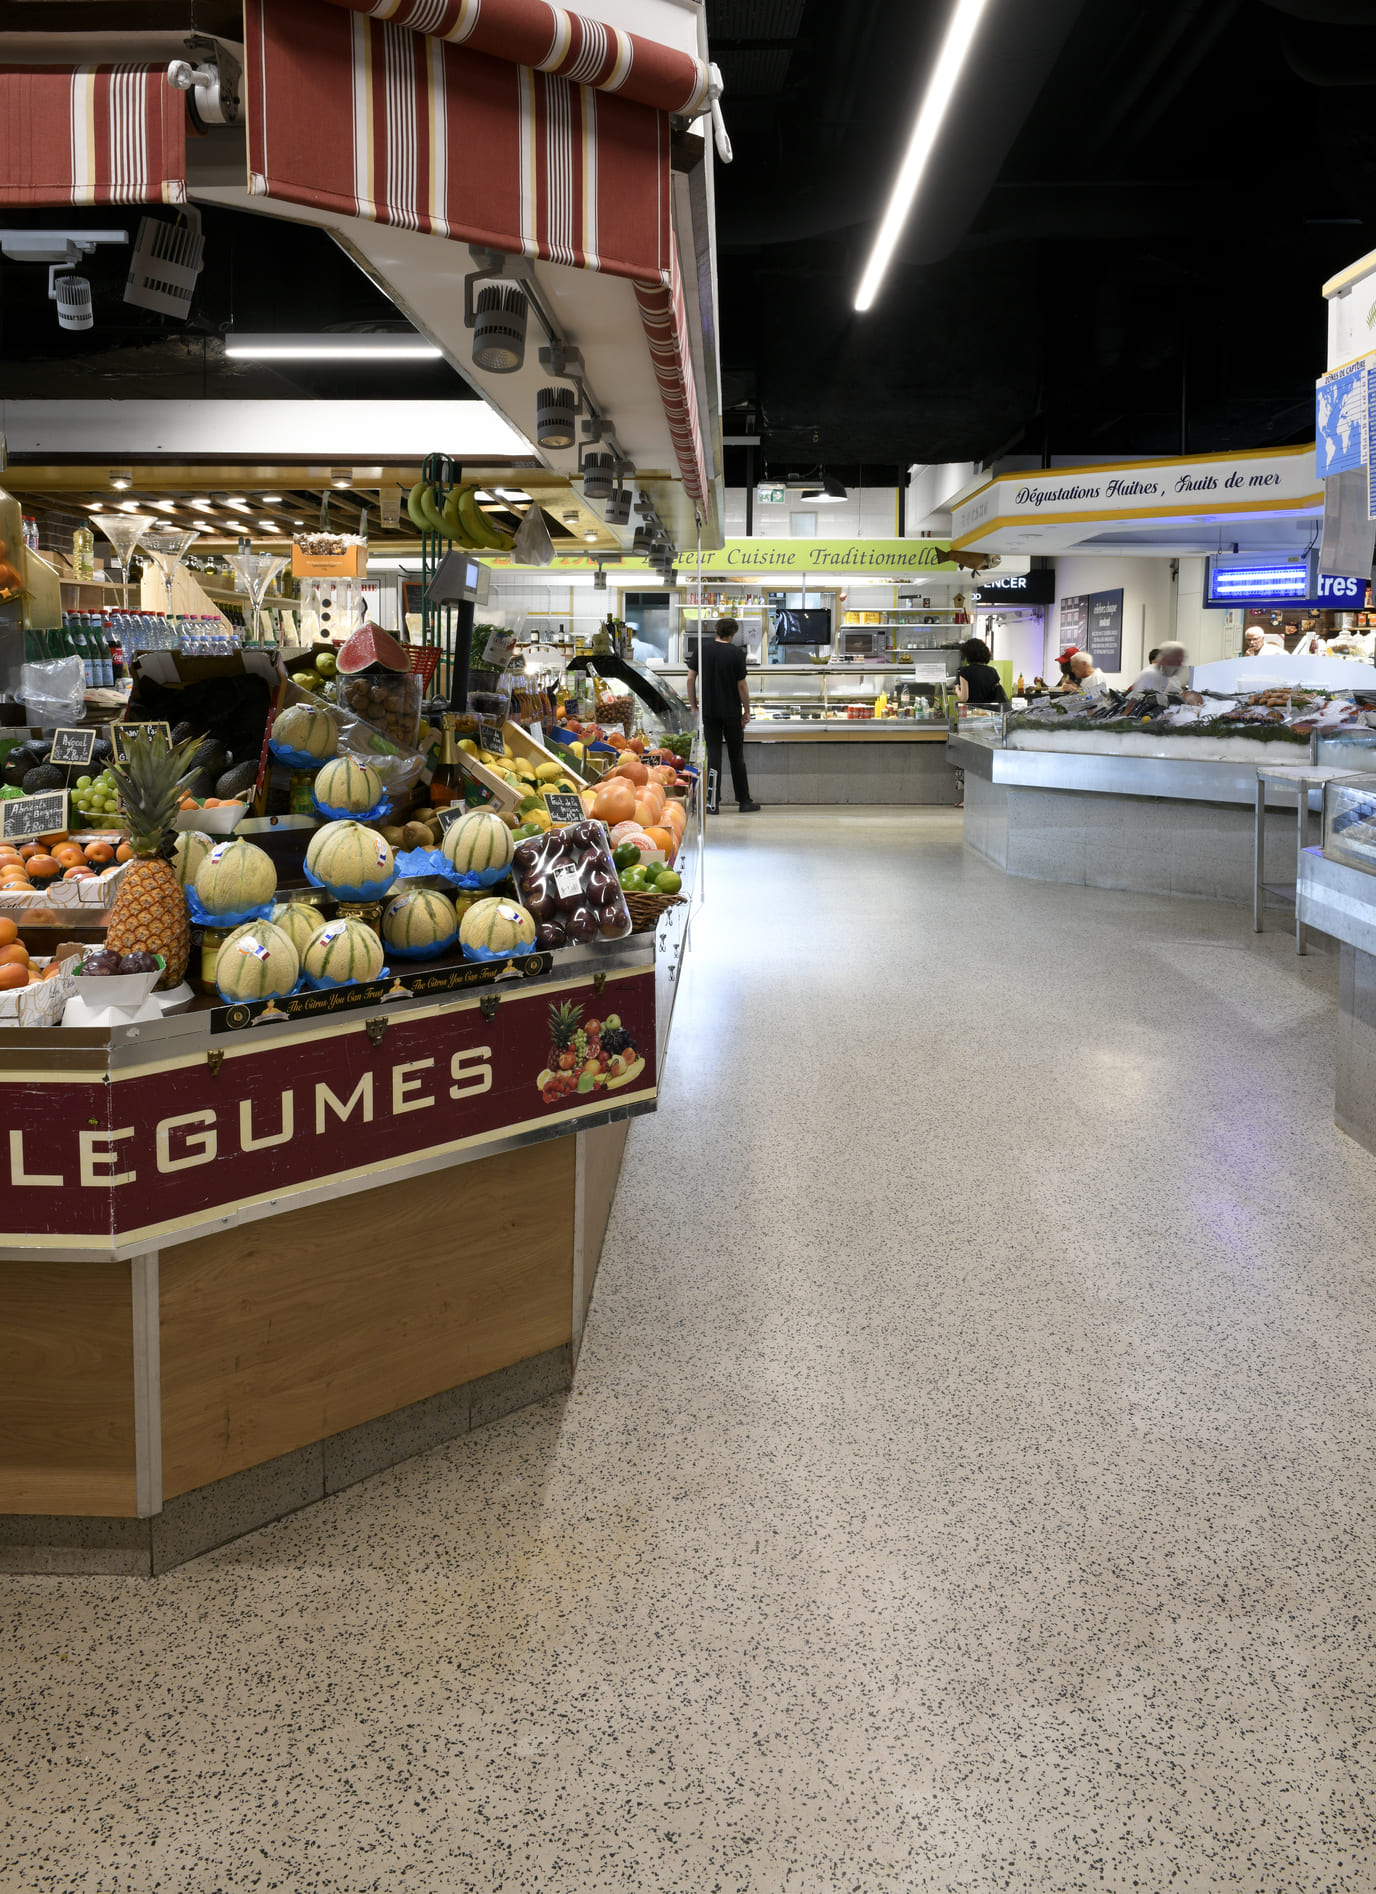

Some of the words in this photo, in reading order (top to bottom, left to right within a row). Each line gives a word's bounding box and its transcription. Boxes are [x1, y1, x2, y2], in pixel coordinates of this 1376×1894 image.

[1325, 373, 1339, 384] ZONES
[1339, 368, 1345, 378] DE
[1346, 360, 1366, 375] CAPTURE
[1015, 485, 1101, 507] Dégustations
[1175, 474, 1219, 494] Fruits
[1224, 471, 1244, 489] de
[1249, 471, 1282, 487] mer
[727, 548, 796, 565] Cuisine
[809, 546, 939, 566] Traditionnelle
[412, 979, 427, 991] The
[427, 976, 448, 988] Citrus
[448, 973, 464, 988] You
[465, 970, 479, 982] Can
[479, 967, 497, 980] Trust
[286, 1000, 302, 1013] The
[304, 998, 327, 1010] Citrus
[327, 993, 344, 1010] You
[346, 990, 361, 1003] Can
[364, 986, 384, 1000] Trust
[8, 1045, 493, 1188] LEGUMES
